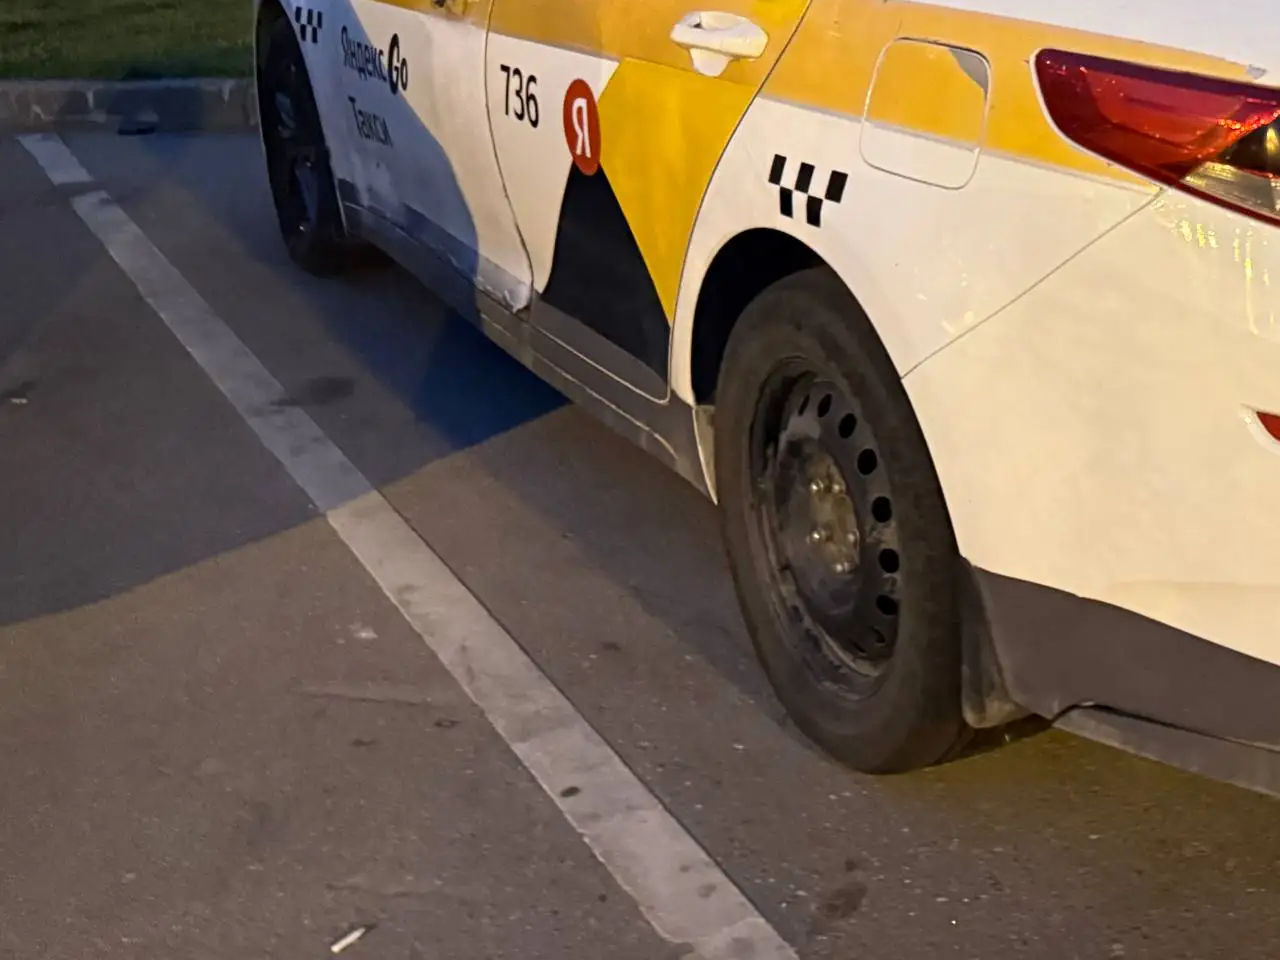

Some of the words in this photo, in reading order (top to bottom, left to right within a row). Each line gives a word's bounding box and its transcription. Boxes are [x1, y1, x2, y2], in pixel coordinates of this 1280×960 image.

[341, 24, 388, 83] Яндекс
[387, 32, 408, 96] Go
[347, 95, 394, 148] Такси
[500, 63, 540, 129] 736
